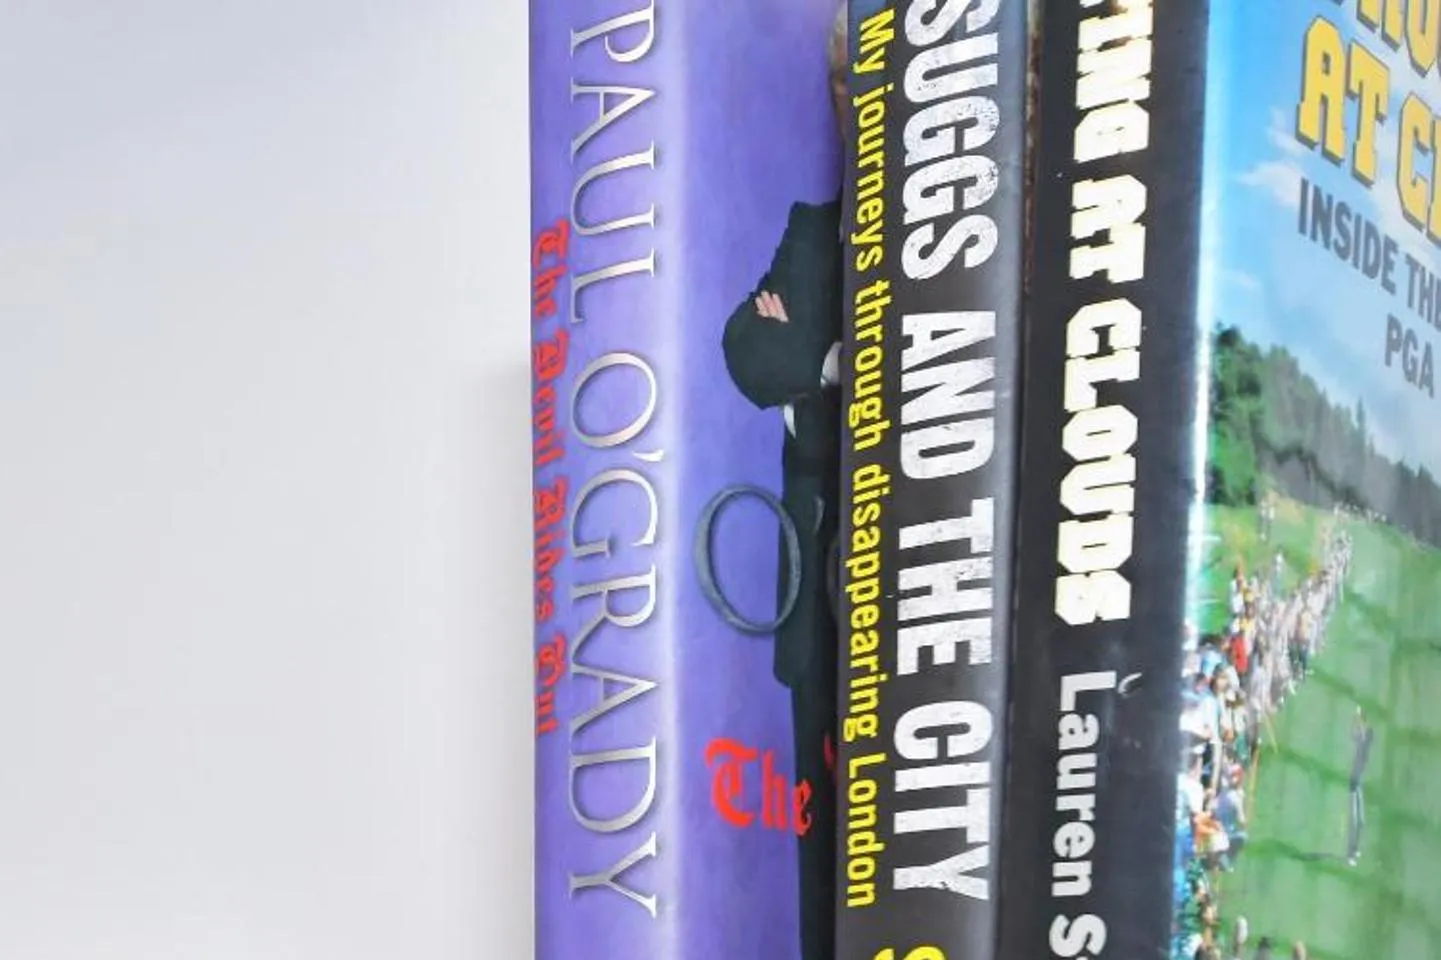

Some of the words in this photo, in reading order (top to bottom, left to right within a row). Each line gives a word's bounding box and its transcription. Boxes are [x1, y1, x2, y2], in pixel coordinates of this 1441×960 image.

[853, 8, 894, 75] My
[1074, 0, 1153, 163] ING
[1295, 15, 1389, 189] AT
[569, 0, 657, 324] PAUL
[851, 82, 894, 272] journeys
[901, 0, 1000, 281] SUGGS
[1069, 173, 1147, 283] AT
[1298, 177, 1398, 296] INSIDE
[848, 280, 892, 451] through
[900, 310, 996, 479] AND
[1384, 313, 1435, 399] PGA
[1054, 298, 1143, 627] CLOUDS
[568, 352, 664, 917] O'GRADY
[843, 463, 891, 742] disappearing
[896, 496, 994, 676] THE
[703, 736, 812, 836] The
[847, 752, 887, 907] London
[893, 700, 993, 900] CITY
[1051, 669, 1117, 897] Lauren
